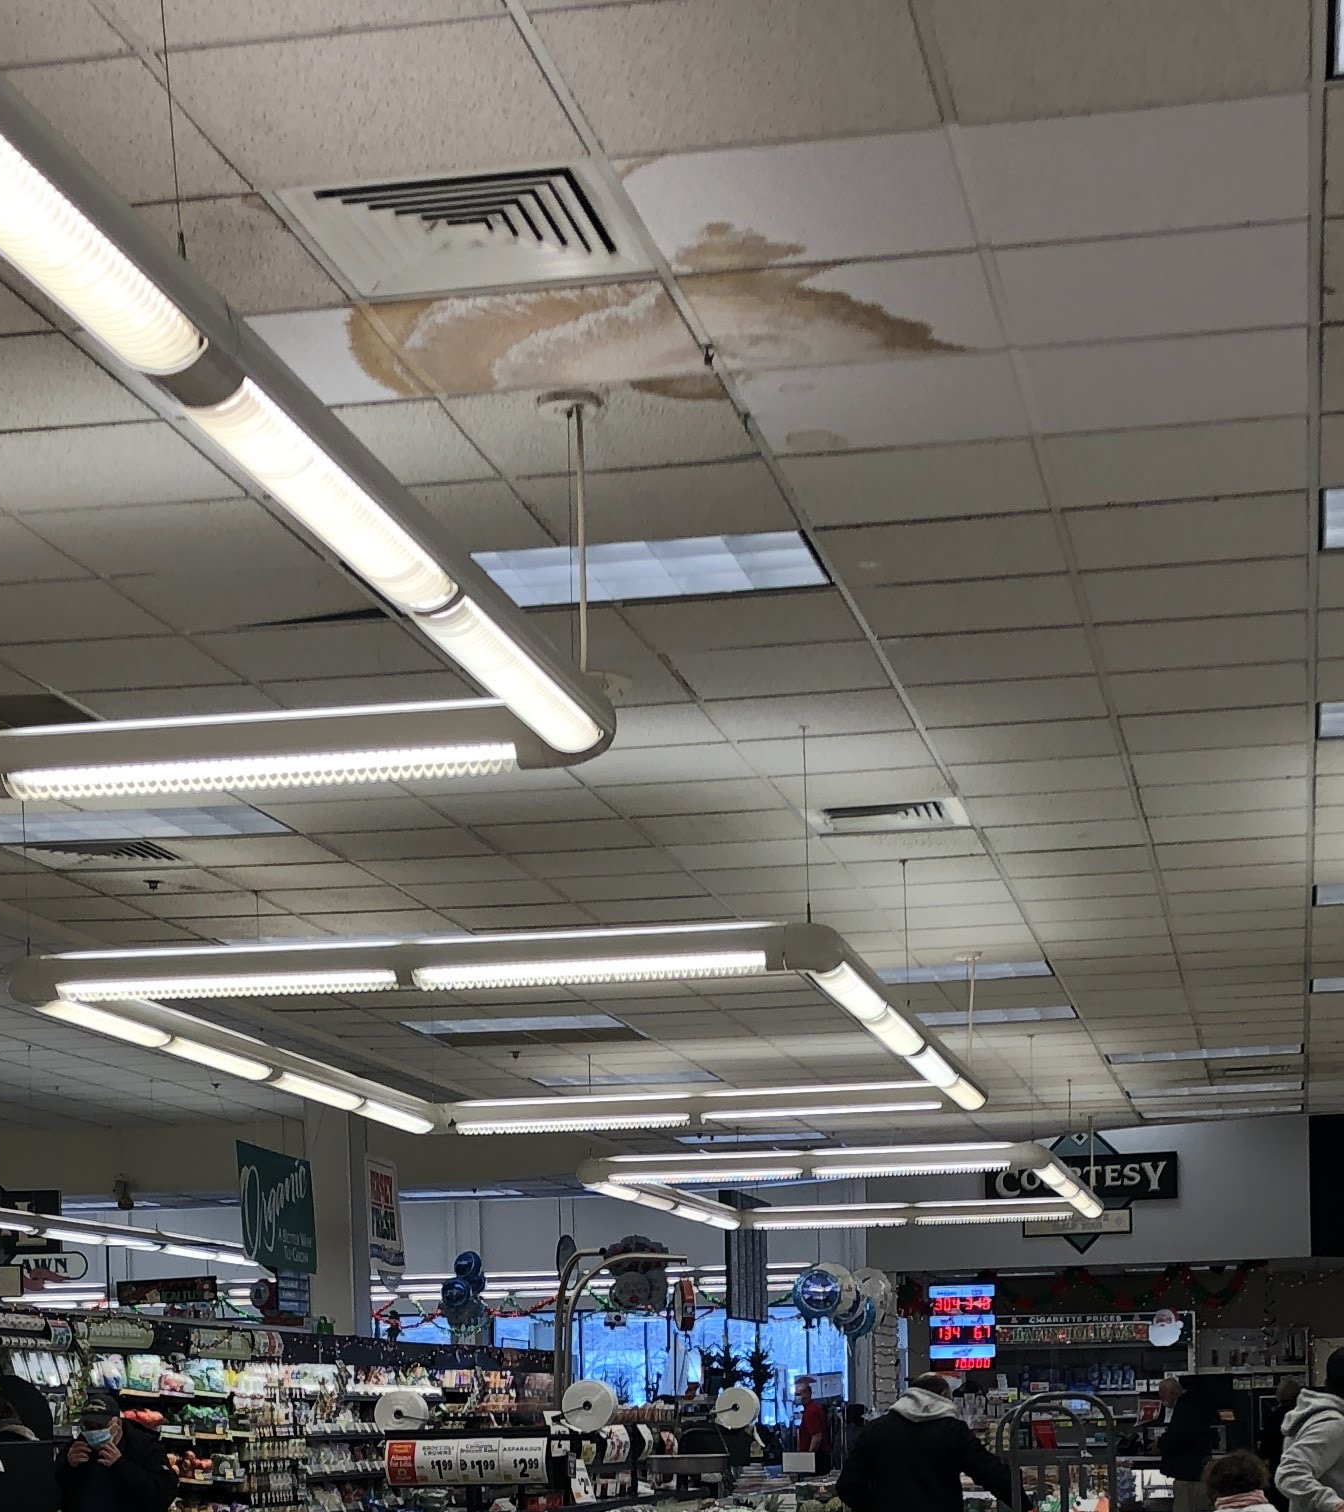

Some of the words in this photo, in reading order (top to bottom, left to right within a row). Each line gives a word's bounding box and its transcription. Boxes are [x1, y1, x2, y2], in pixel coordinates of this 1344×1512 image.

[995, 1160, 1168, 1199] COTESY
[240, 1159, 307, 1260] Organic
[1028, 1315, 1084, 1324] CIGARETTE
[1086, 1314, 1122, 1323] PRICES
